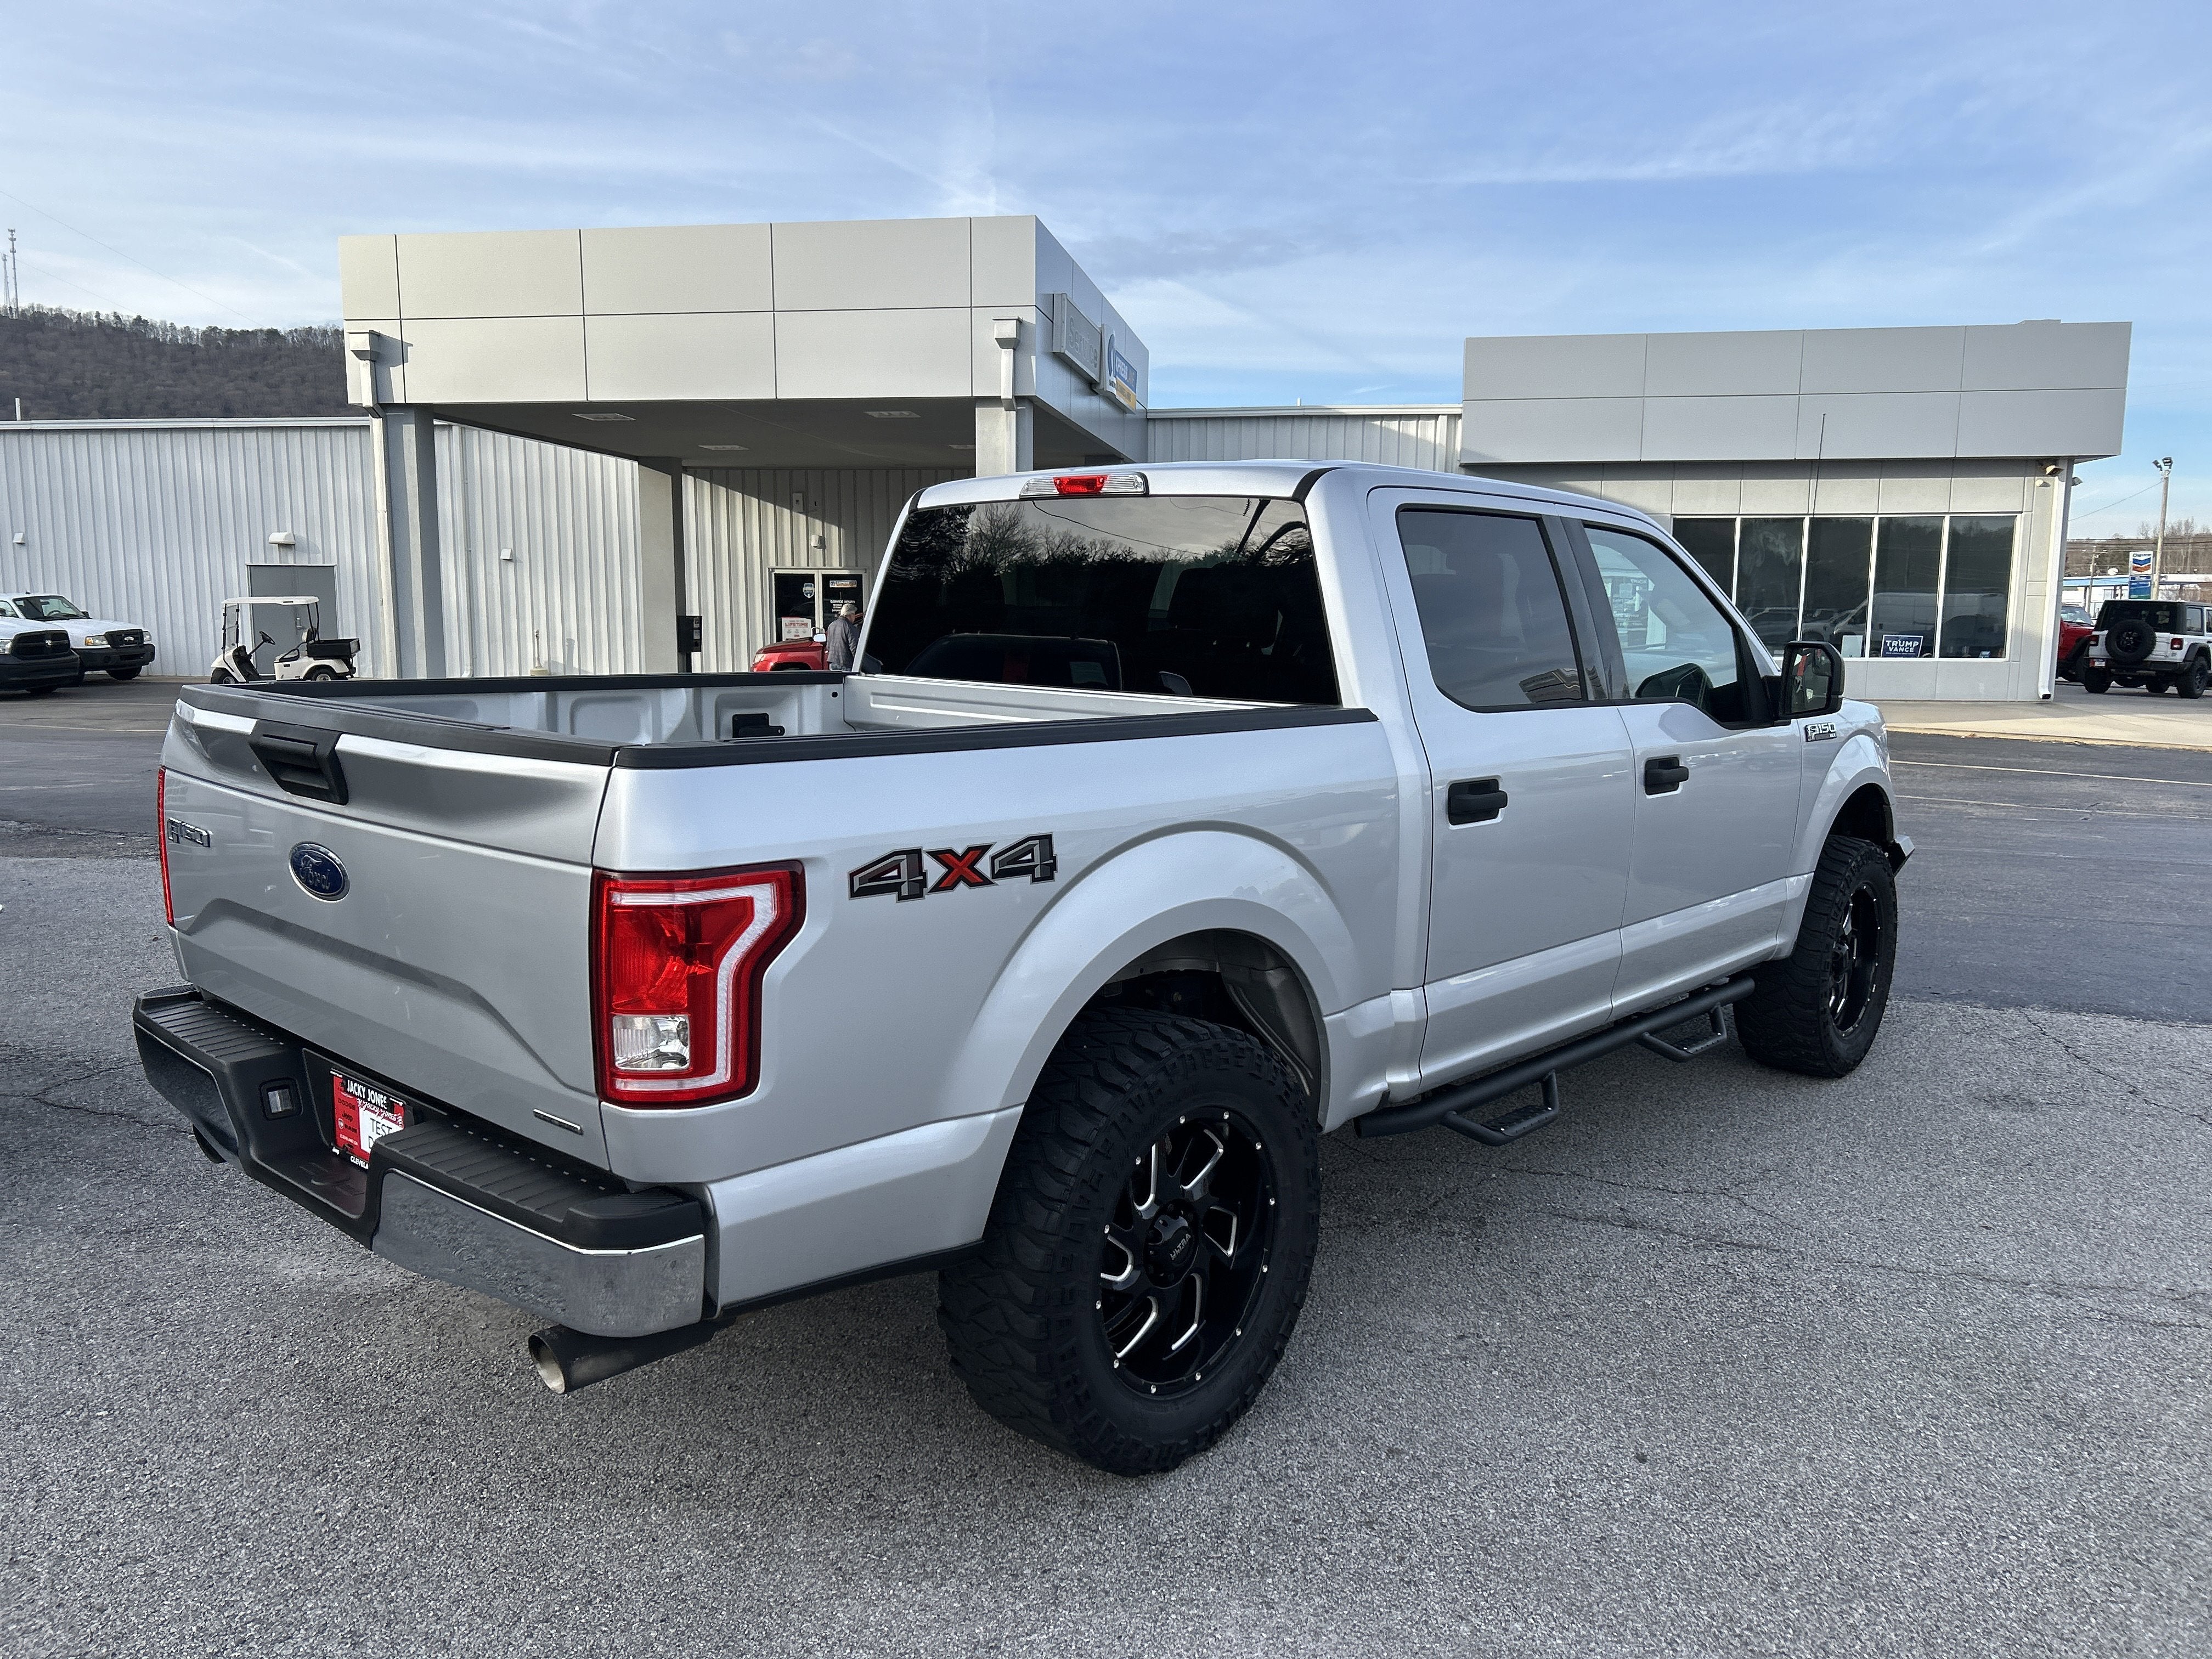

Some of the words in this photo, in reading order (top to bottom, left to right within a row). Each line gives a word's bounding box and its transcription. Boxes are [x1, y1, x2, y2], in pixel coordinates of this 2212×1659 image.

[1069, 317, 1098, 369] Service
[300, 854, 331, 890] Ford
[347, 1080, 365, 1099] JACKY
[368, 1088, 387, 1109] JONES
[370, 1118, 392, 1136] TEST
[350, 1156, 369, 1169] CLEVELA
[1170, 1234, 1191, 1260] ULTRA
